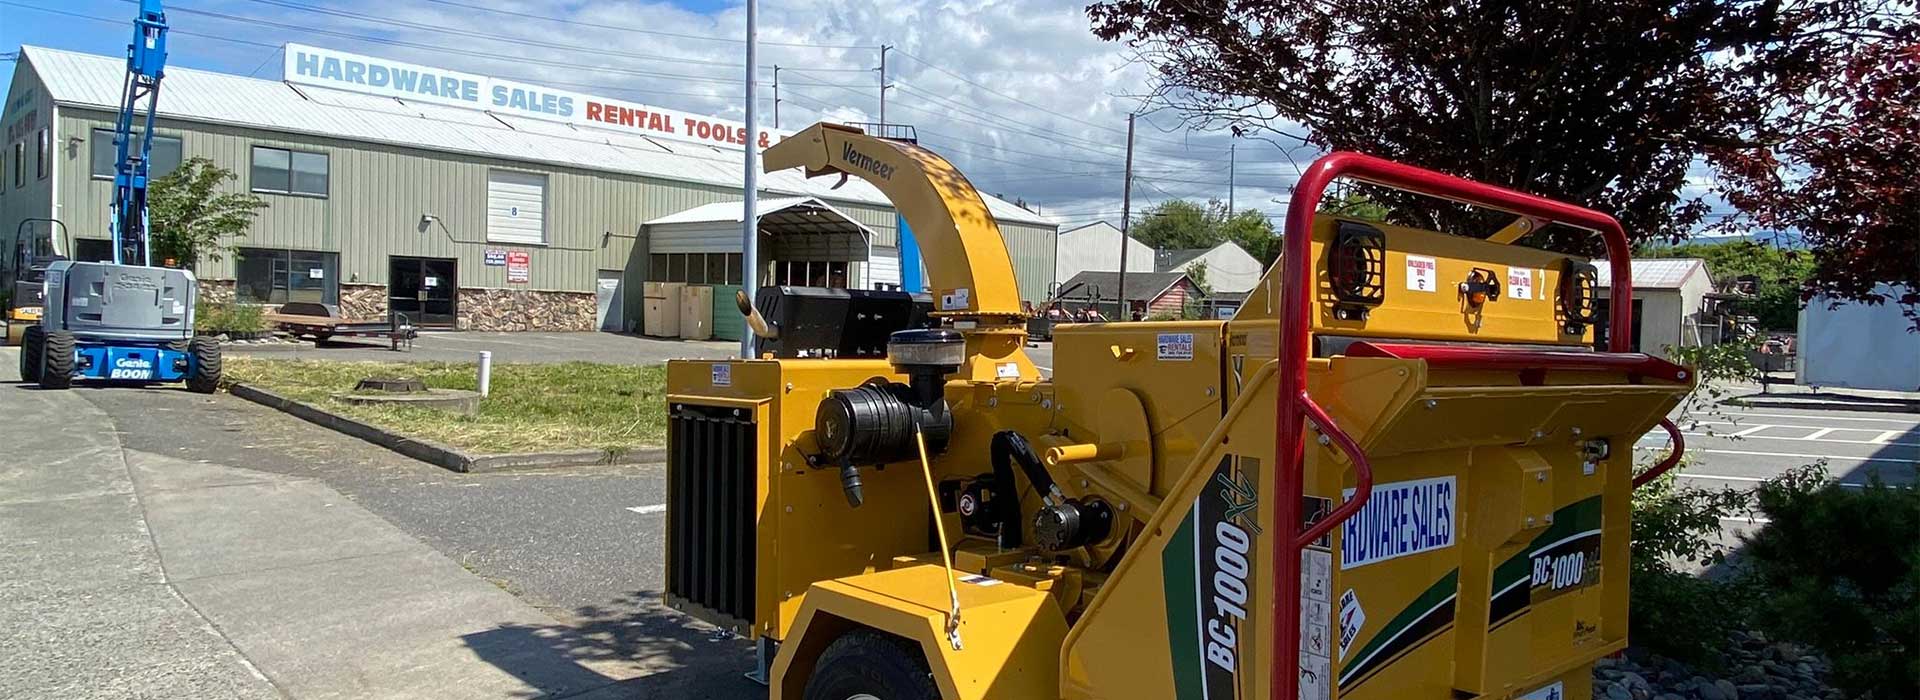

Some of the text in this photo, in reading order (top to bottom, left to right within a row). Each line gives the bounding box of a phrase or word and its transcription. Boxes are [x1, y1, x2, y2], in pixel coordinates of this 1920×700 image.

[296, 52, 770, 149] HARDWARE SALES RENTAL TOOLS &
[842, 140, 895, 181] Vermeer
[511, 206, 518, 216] 8
[1167, 343, 1192, 352] RENTALS
[116, 357, 151, 369] Genie
[1341, 487, 1408, 565] ARDWARE
[1411, 481, 1451, 552] SALES
